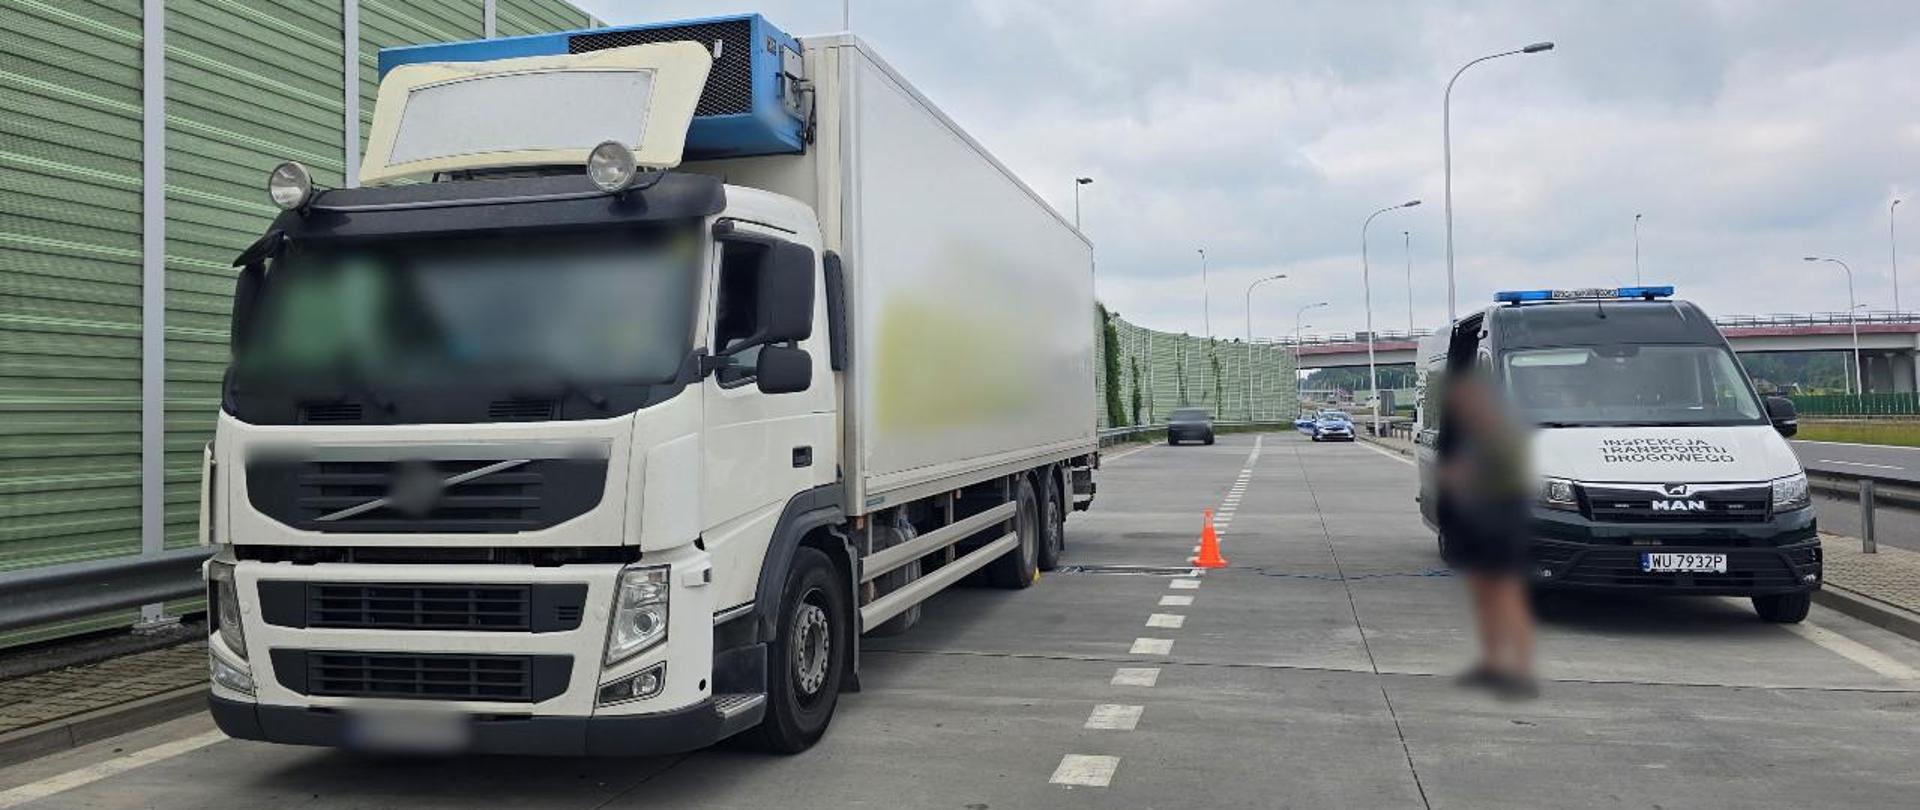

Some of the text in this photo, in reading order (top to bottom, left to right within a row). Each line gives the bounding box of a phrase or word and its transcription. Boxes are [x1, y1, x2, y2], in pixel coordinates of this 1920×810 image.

[1602, 438, 1709, 446] INSPEKCJA
[1603, 453, 1735, 463] DROGOWEGO
[1651, 500, 1706, 511] MAN
[1652, 554, 1723, 569] WU 7932P
